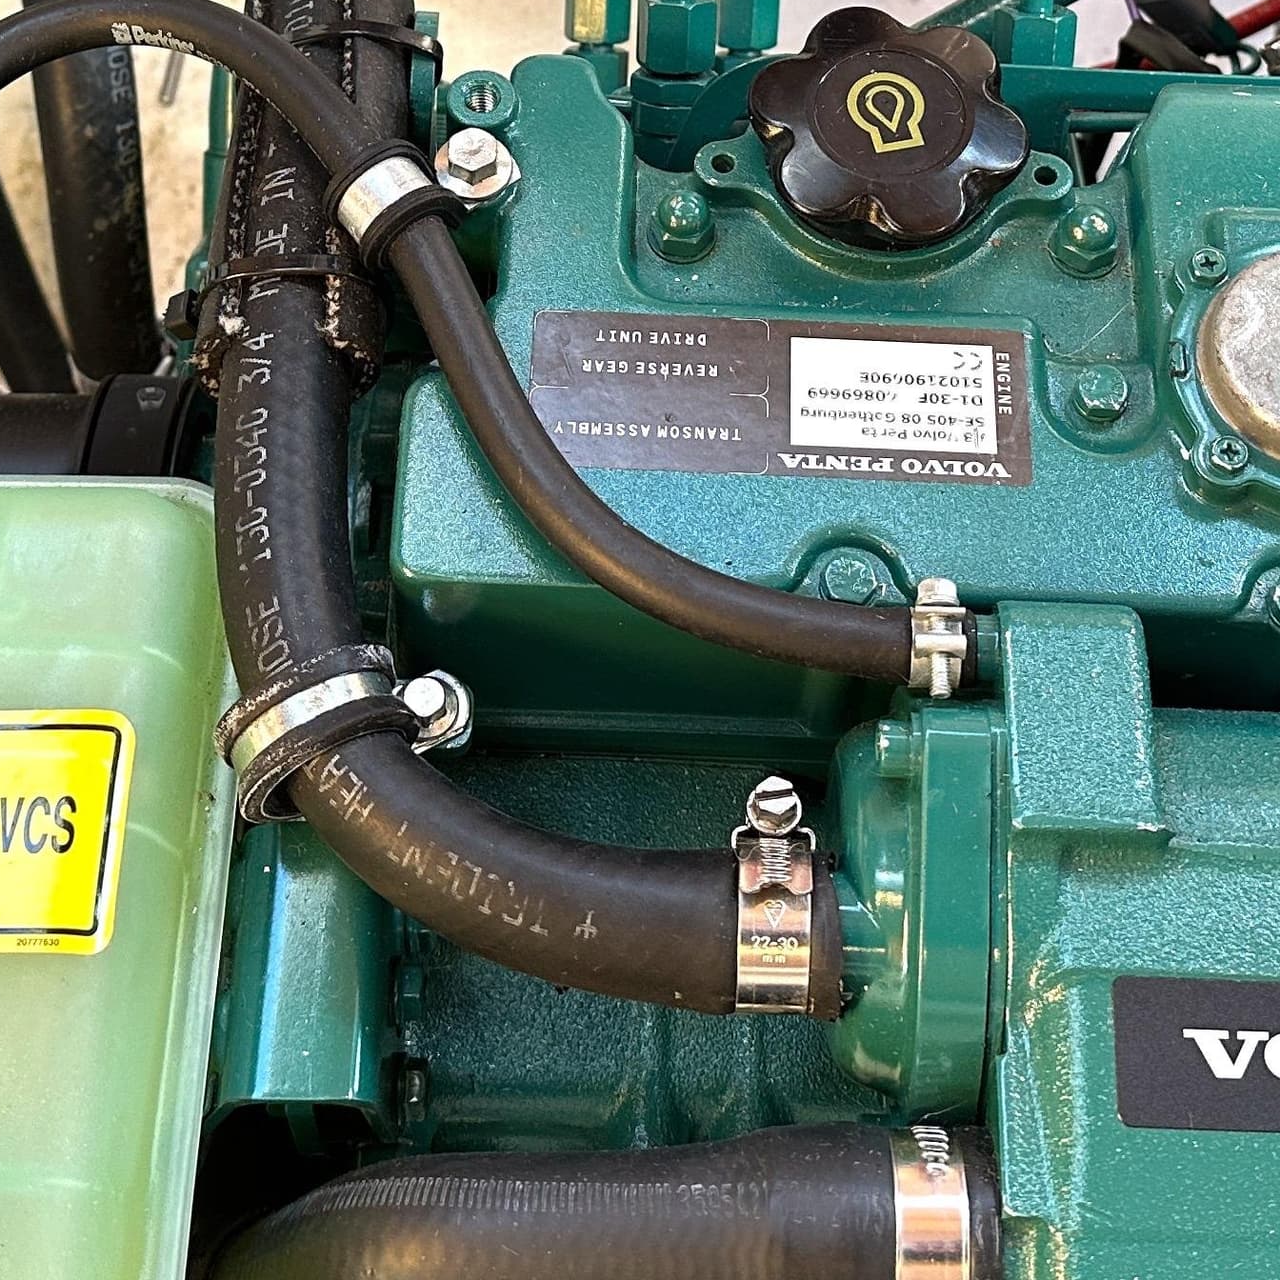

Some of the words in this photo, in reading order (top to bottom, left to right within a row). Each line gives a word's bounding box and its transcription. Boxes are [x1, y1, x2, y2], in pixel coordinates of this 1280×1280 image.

[260, 166, 297, 207] IN
[594, 328, 642, 344] UNIT
[649, 331, 707, 346] DRIVE
[581, 358, 629, 374] GEAR
[635, 361, 719, 377] REVERSE
[995, 351, 1013, 415] ENGINE
[916, 391, 984, 407] D1-30F
[900, 412, 922, 426] 08
[553, 420, 651, 438] ASSEMBLY
[656, 424, 742, 441] TRANSOM
[777, 452, 894, 475] PENTA
[900, 457, 1012, 479] VOLVO
